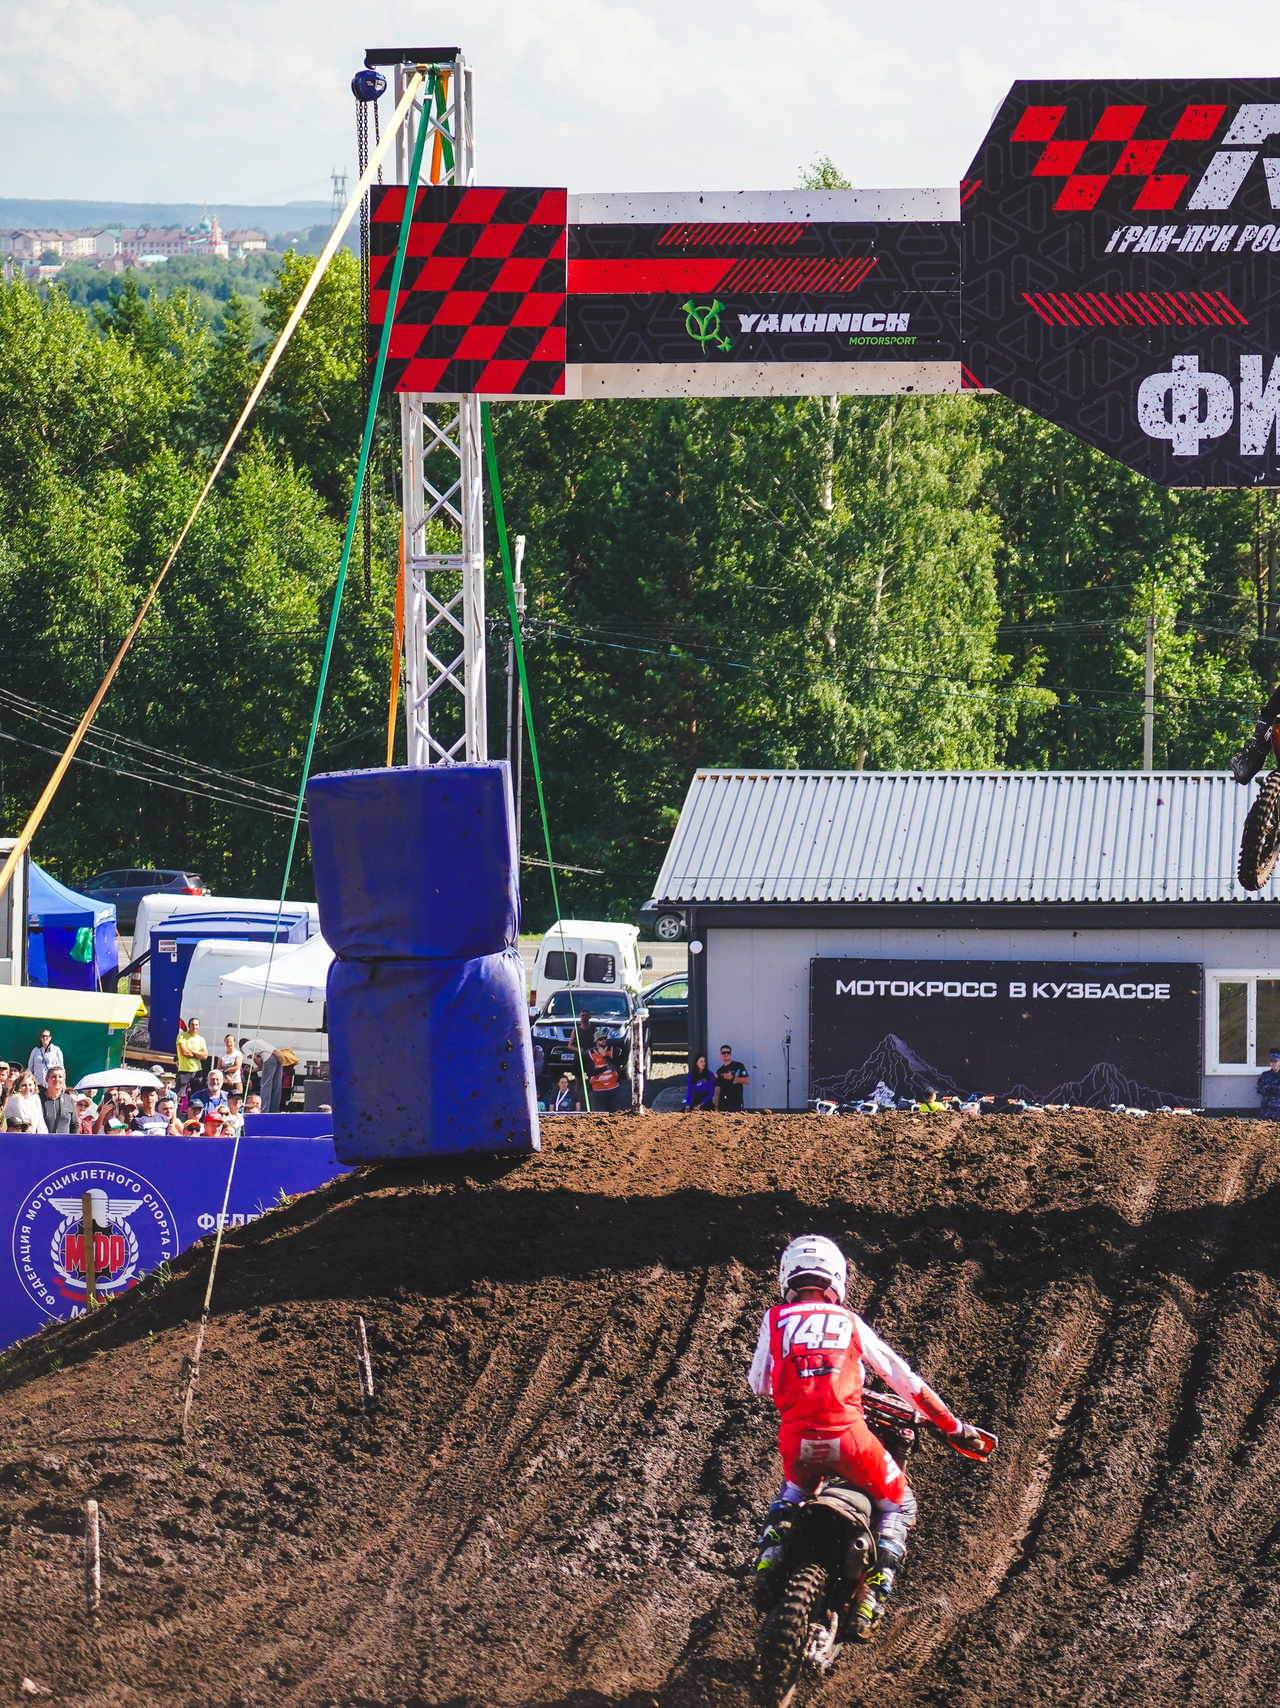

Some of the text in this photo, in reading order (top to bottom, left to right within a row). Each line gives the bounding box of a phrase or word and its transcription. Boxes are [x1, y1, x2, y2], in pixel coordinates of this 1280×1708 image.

[1104, 225, 1238, 253] ГРАН-ПРИ
[737, 313, 910, 332] YAKHNICH
[848, 336, 917, 346] MOTORSPORT
[835, 979, 1171, 1000] МОТОКРОСС В КУЗБАССЕ
[20, 1169, 171, 1306] ФЕДЕРАЦИЯ МОТОЦИКЛЕТНОГО СПОРТА
[776, 1313, 853, 1359] 749
